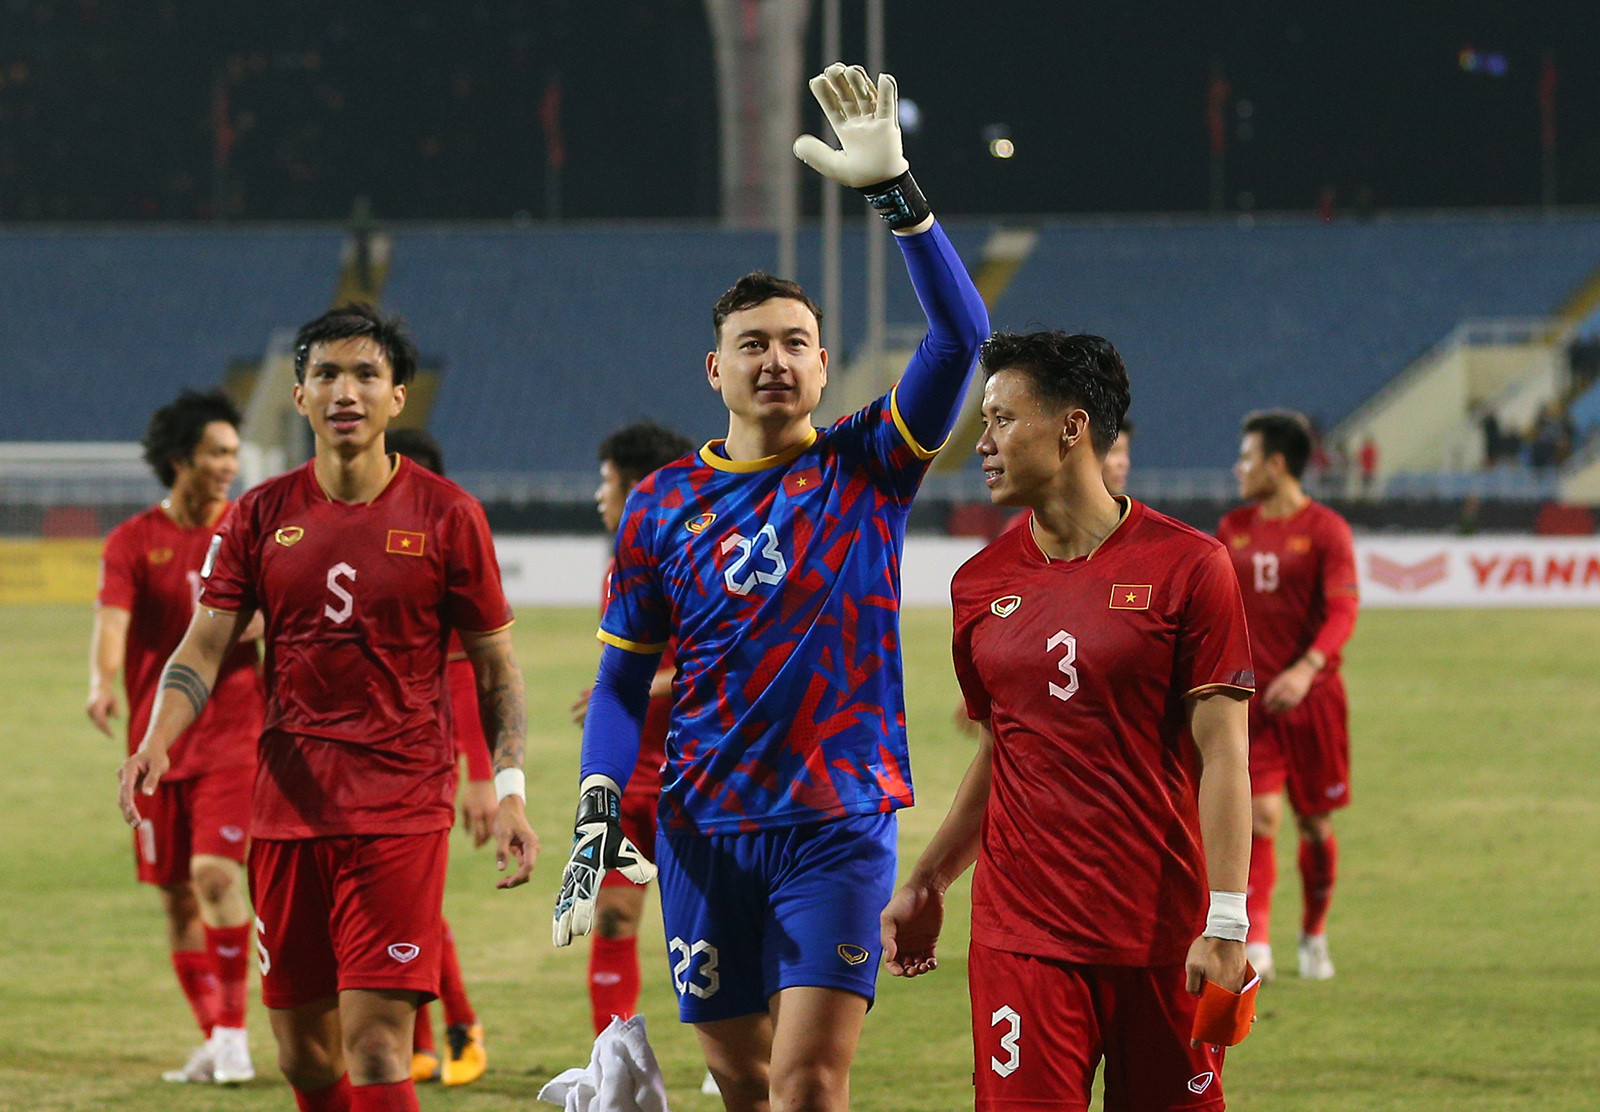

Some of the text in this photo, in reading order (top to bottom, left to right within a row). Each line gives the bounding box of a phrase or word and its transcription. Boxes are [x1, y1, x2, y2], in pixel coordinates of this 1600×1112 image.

[720, 523, 787, 596] 23
[1252, 551, 1280, 593] 13
[1046, 629, 1080, 701] 3
[669, 936, 720, 999] 23
[991, 1004, 1021, 1078] 3
